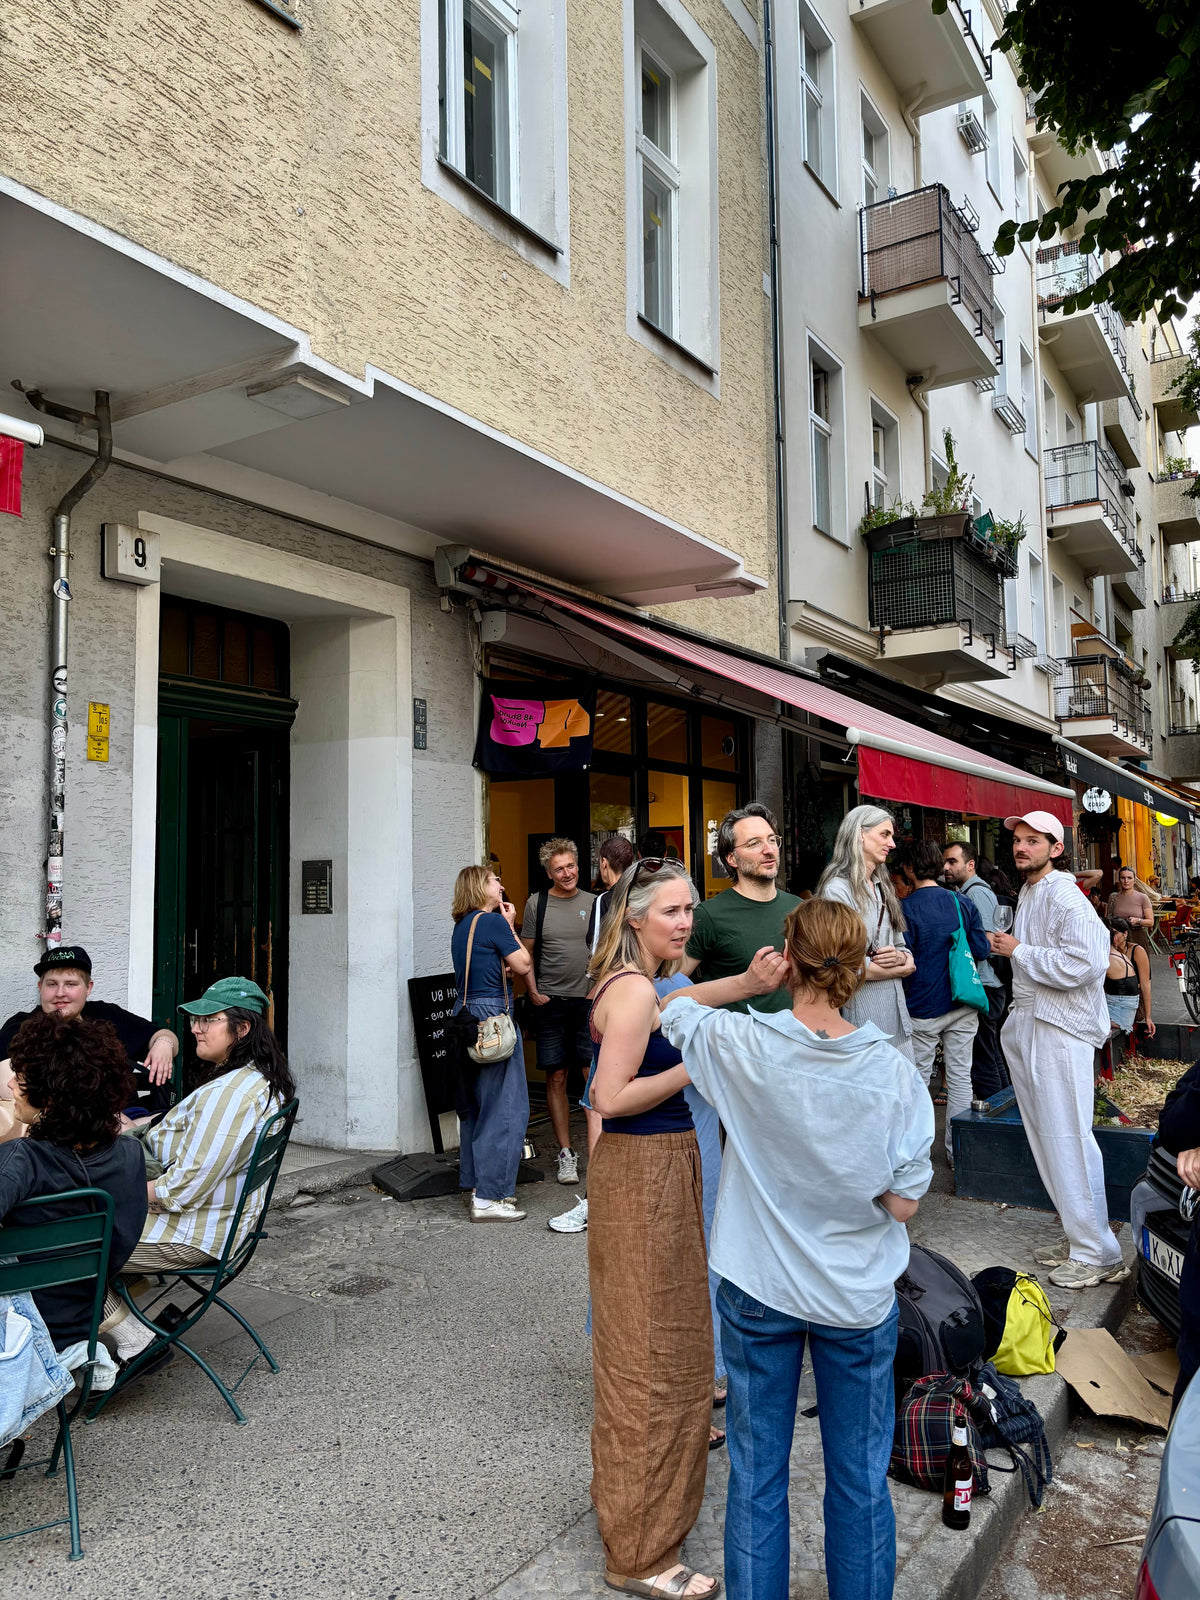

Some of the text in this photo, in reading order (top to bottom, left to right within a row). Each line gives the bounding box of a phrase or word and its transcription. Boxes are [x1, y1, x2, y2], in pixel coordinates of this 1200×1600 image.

[134, 537, 147, 568] 9
[431, 989, 444, 1002] U8
[1152, 1237, 1161, 1266] K
